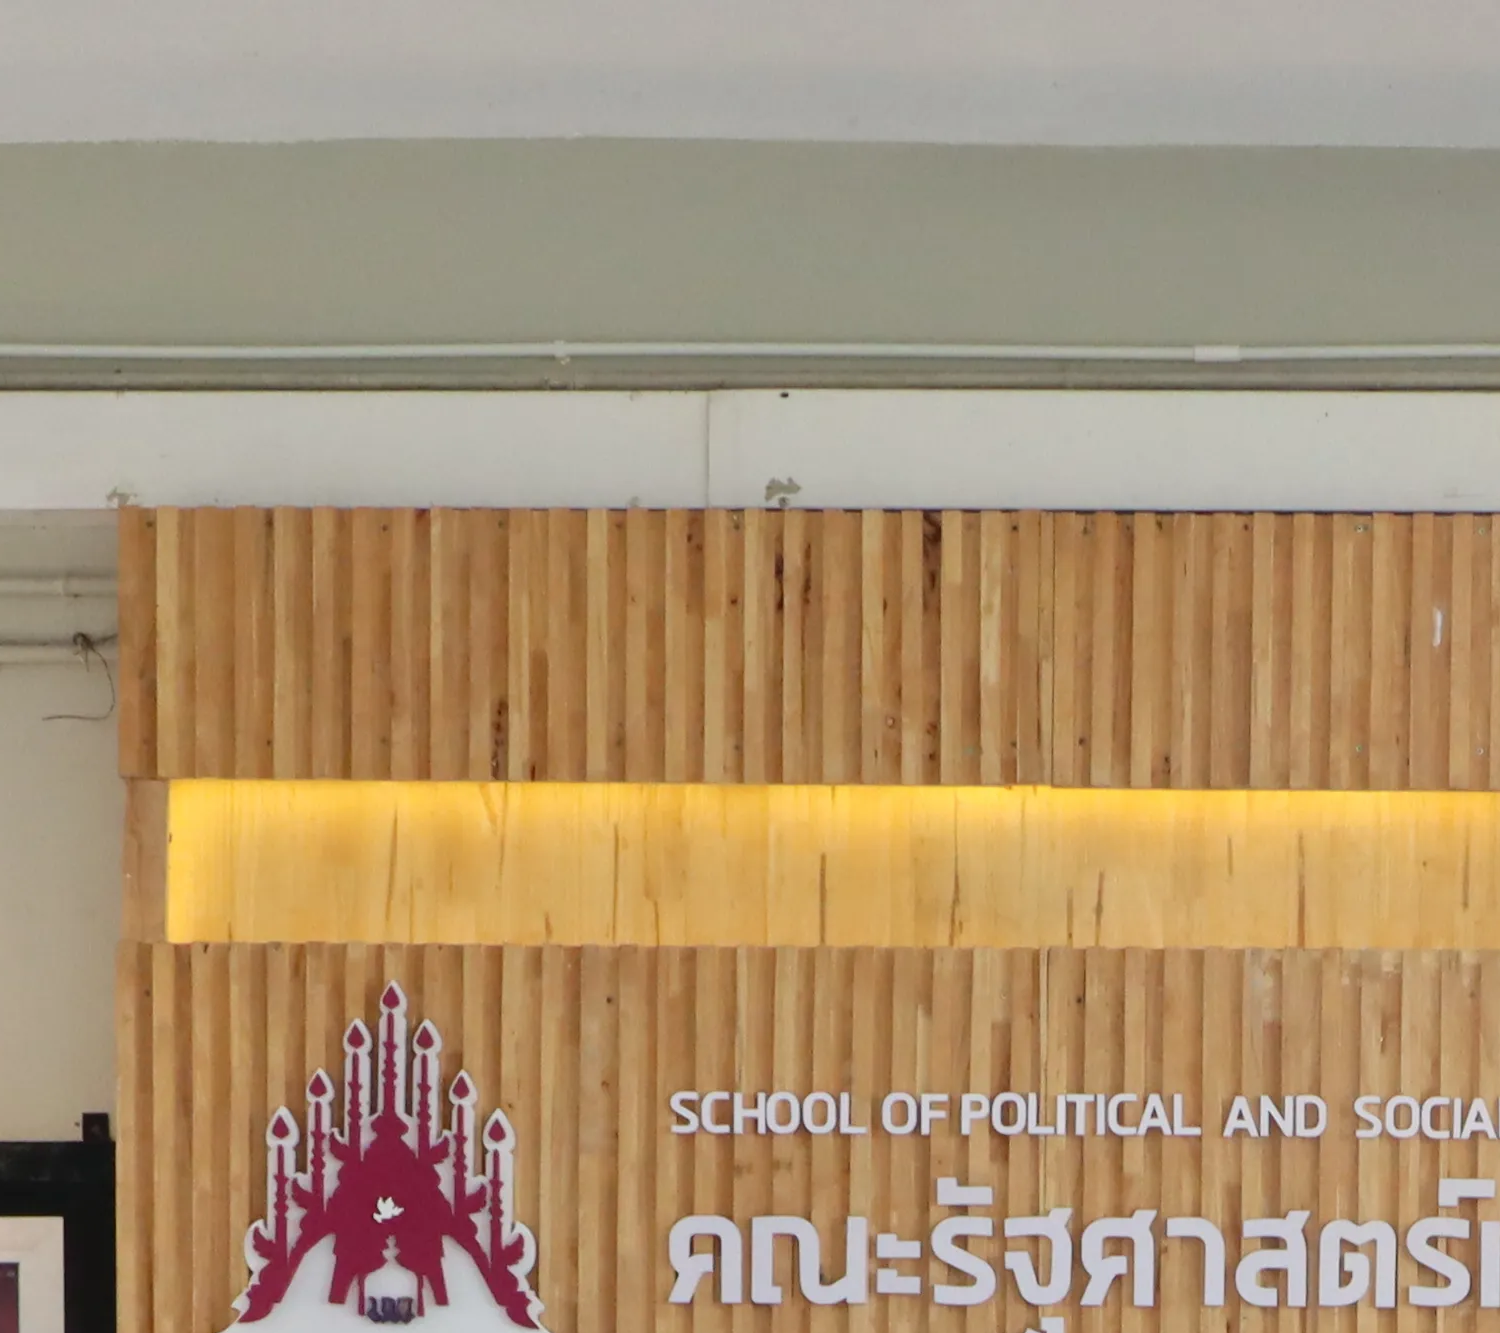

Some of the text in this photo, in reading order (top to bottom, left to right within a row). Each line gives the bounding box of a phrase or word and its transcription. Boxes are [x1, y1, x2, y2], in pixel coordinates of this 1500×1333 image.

[669, 1090, 866, 1135] SCHOOL
[881, 1090, 947, 1136] OF
[960, 1092, 1202, 1138] POLITICAL
[1223, 1094, 1328, 1139] AND
